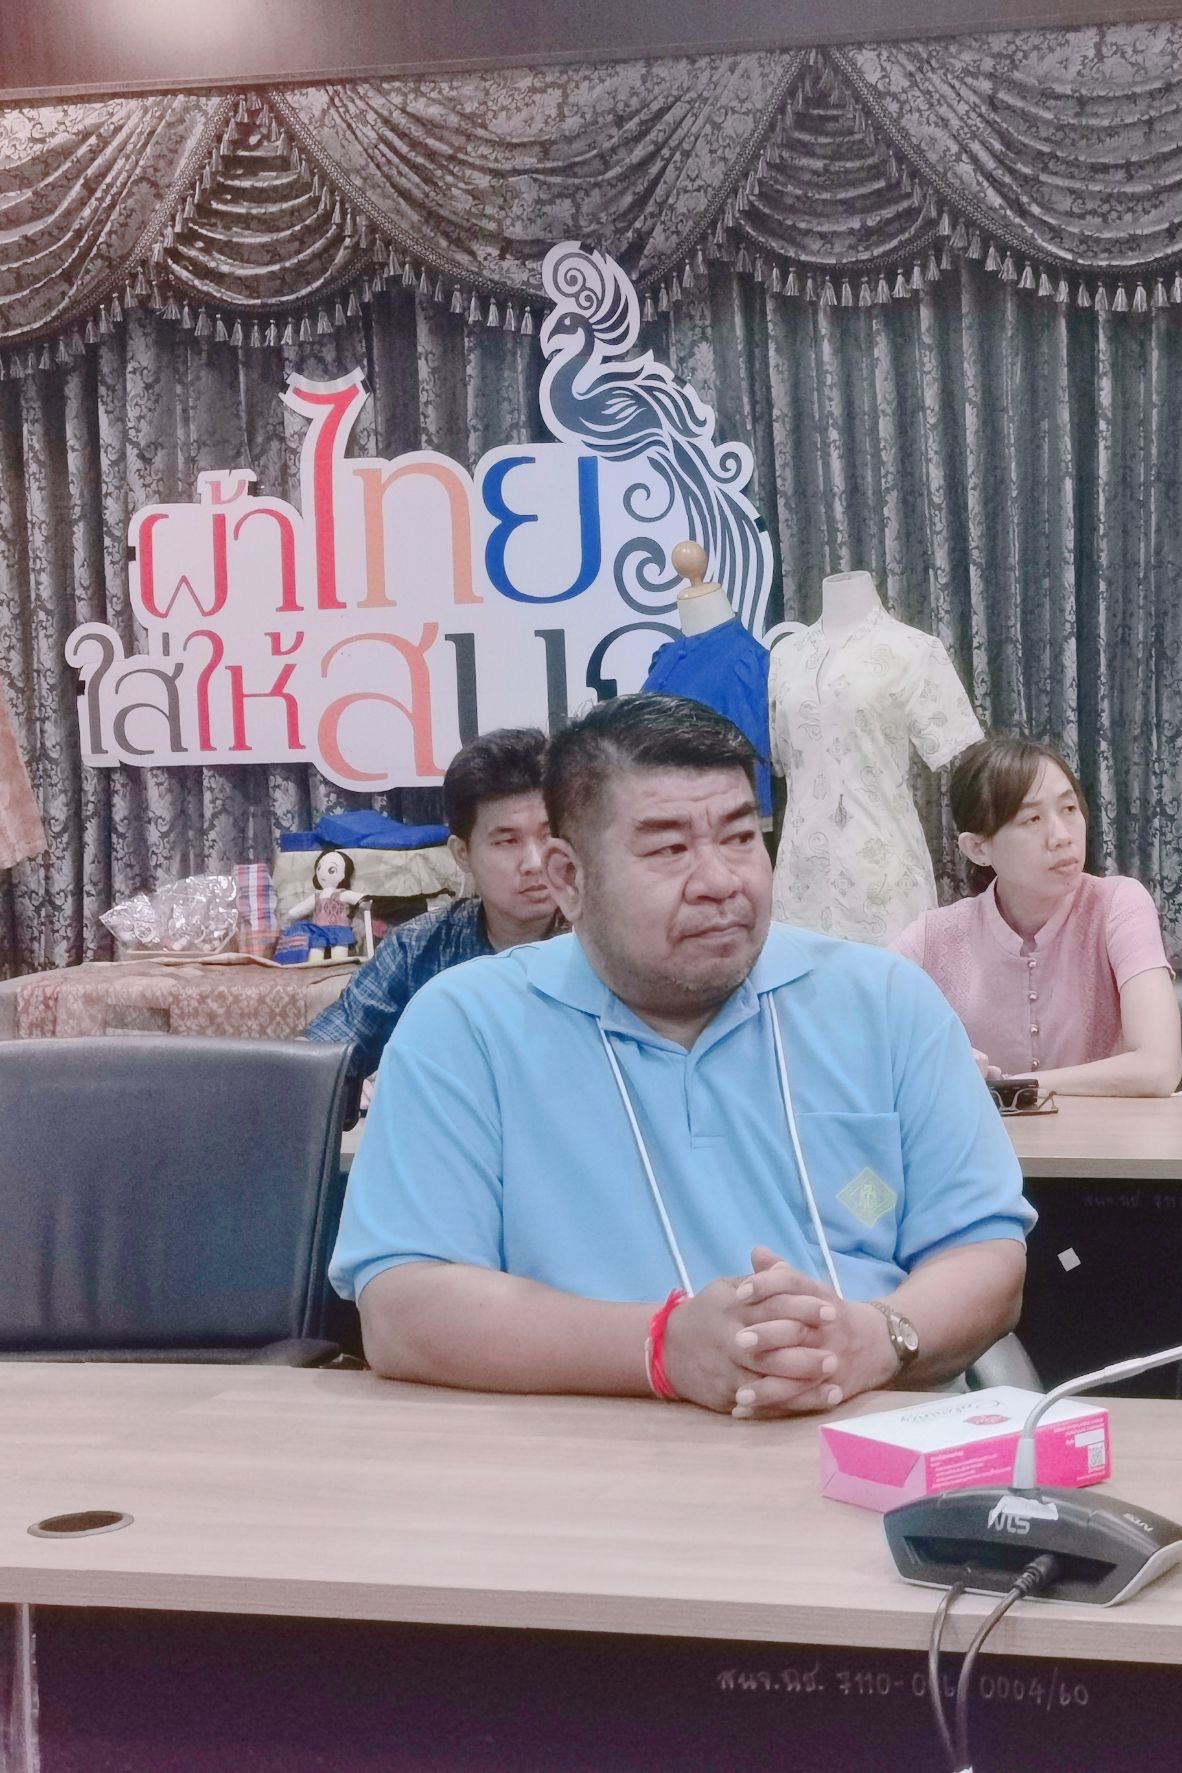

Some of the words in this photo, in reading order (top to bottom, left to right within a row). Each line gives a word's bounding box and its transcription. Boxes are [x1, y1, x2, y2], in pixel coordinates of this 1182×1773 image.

[138, 384, 602, 619] ผ้าไทย
[73, 620, 685, 782] ใส่ให้สน
